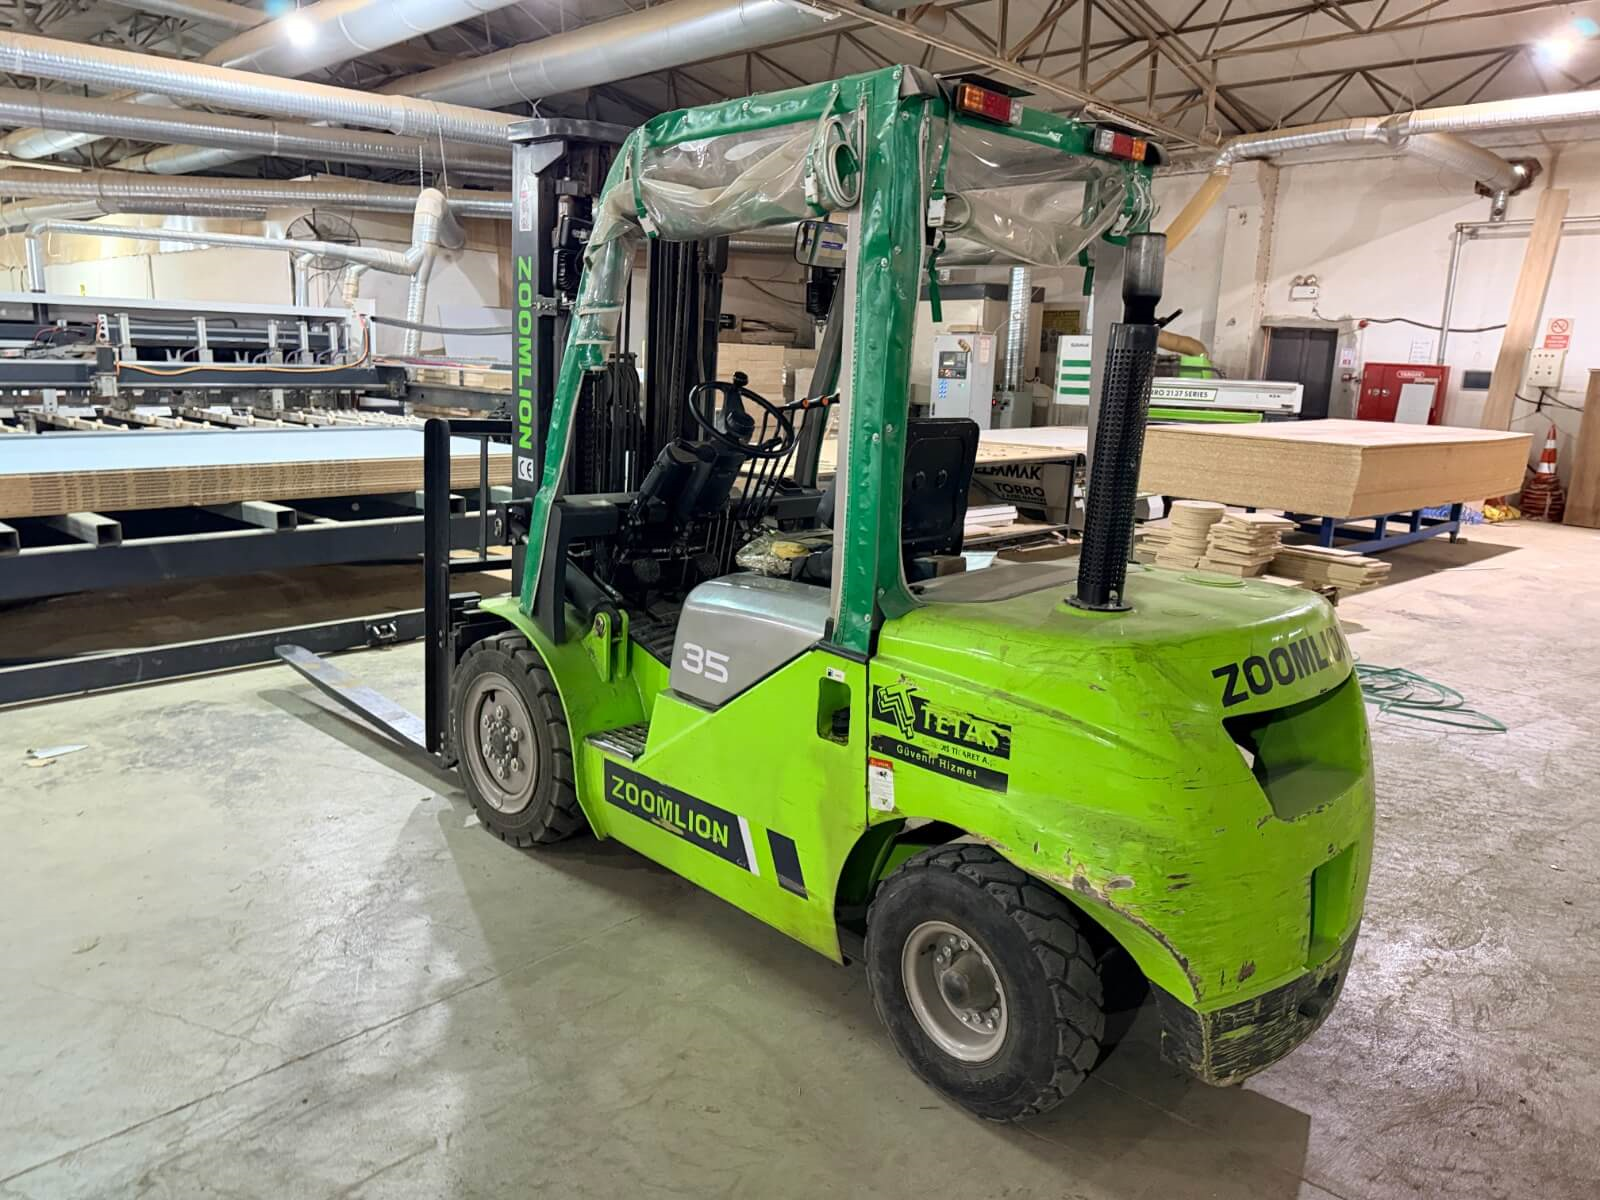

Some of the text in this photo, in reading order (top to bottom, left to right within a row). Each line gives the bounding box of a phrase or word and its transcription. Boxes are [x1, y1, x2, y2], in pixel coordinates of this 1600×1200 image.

[518, 256, 532, 449] ZOOMLION
[993, 482, 1045, 497] TORRO
[681, 642, 730, 683] 35
[1211, 625, 1346, 708] ZOOMLIO
[939, 758, 977, 779] Hizmet
[611, 775, 729, 848] ZOOMLION
